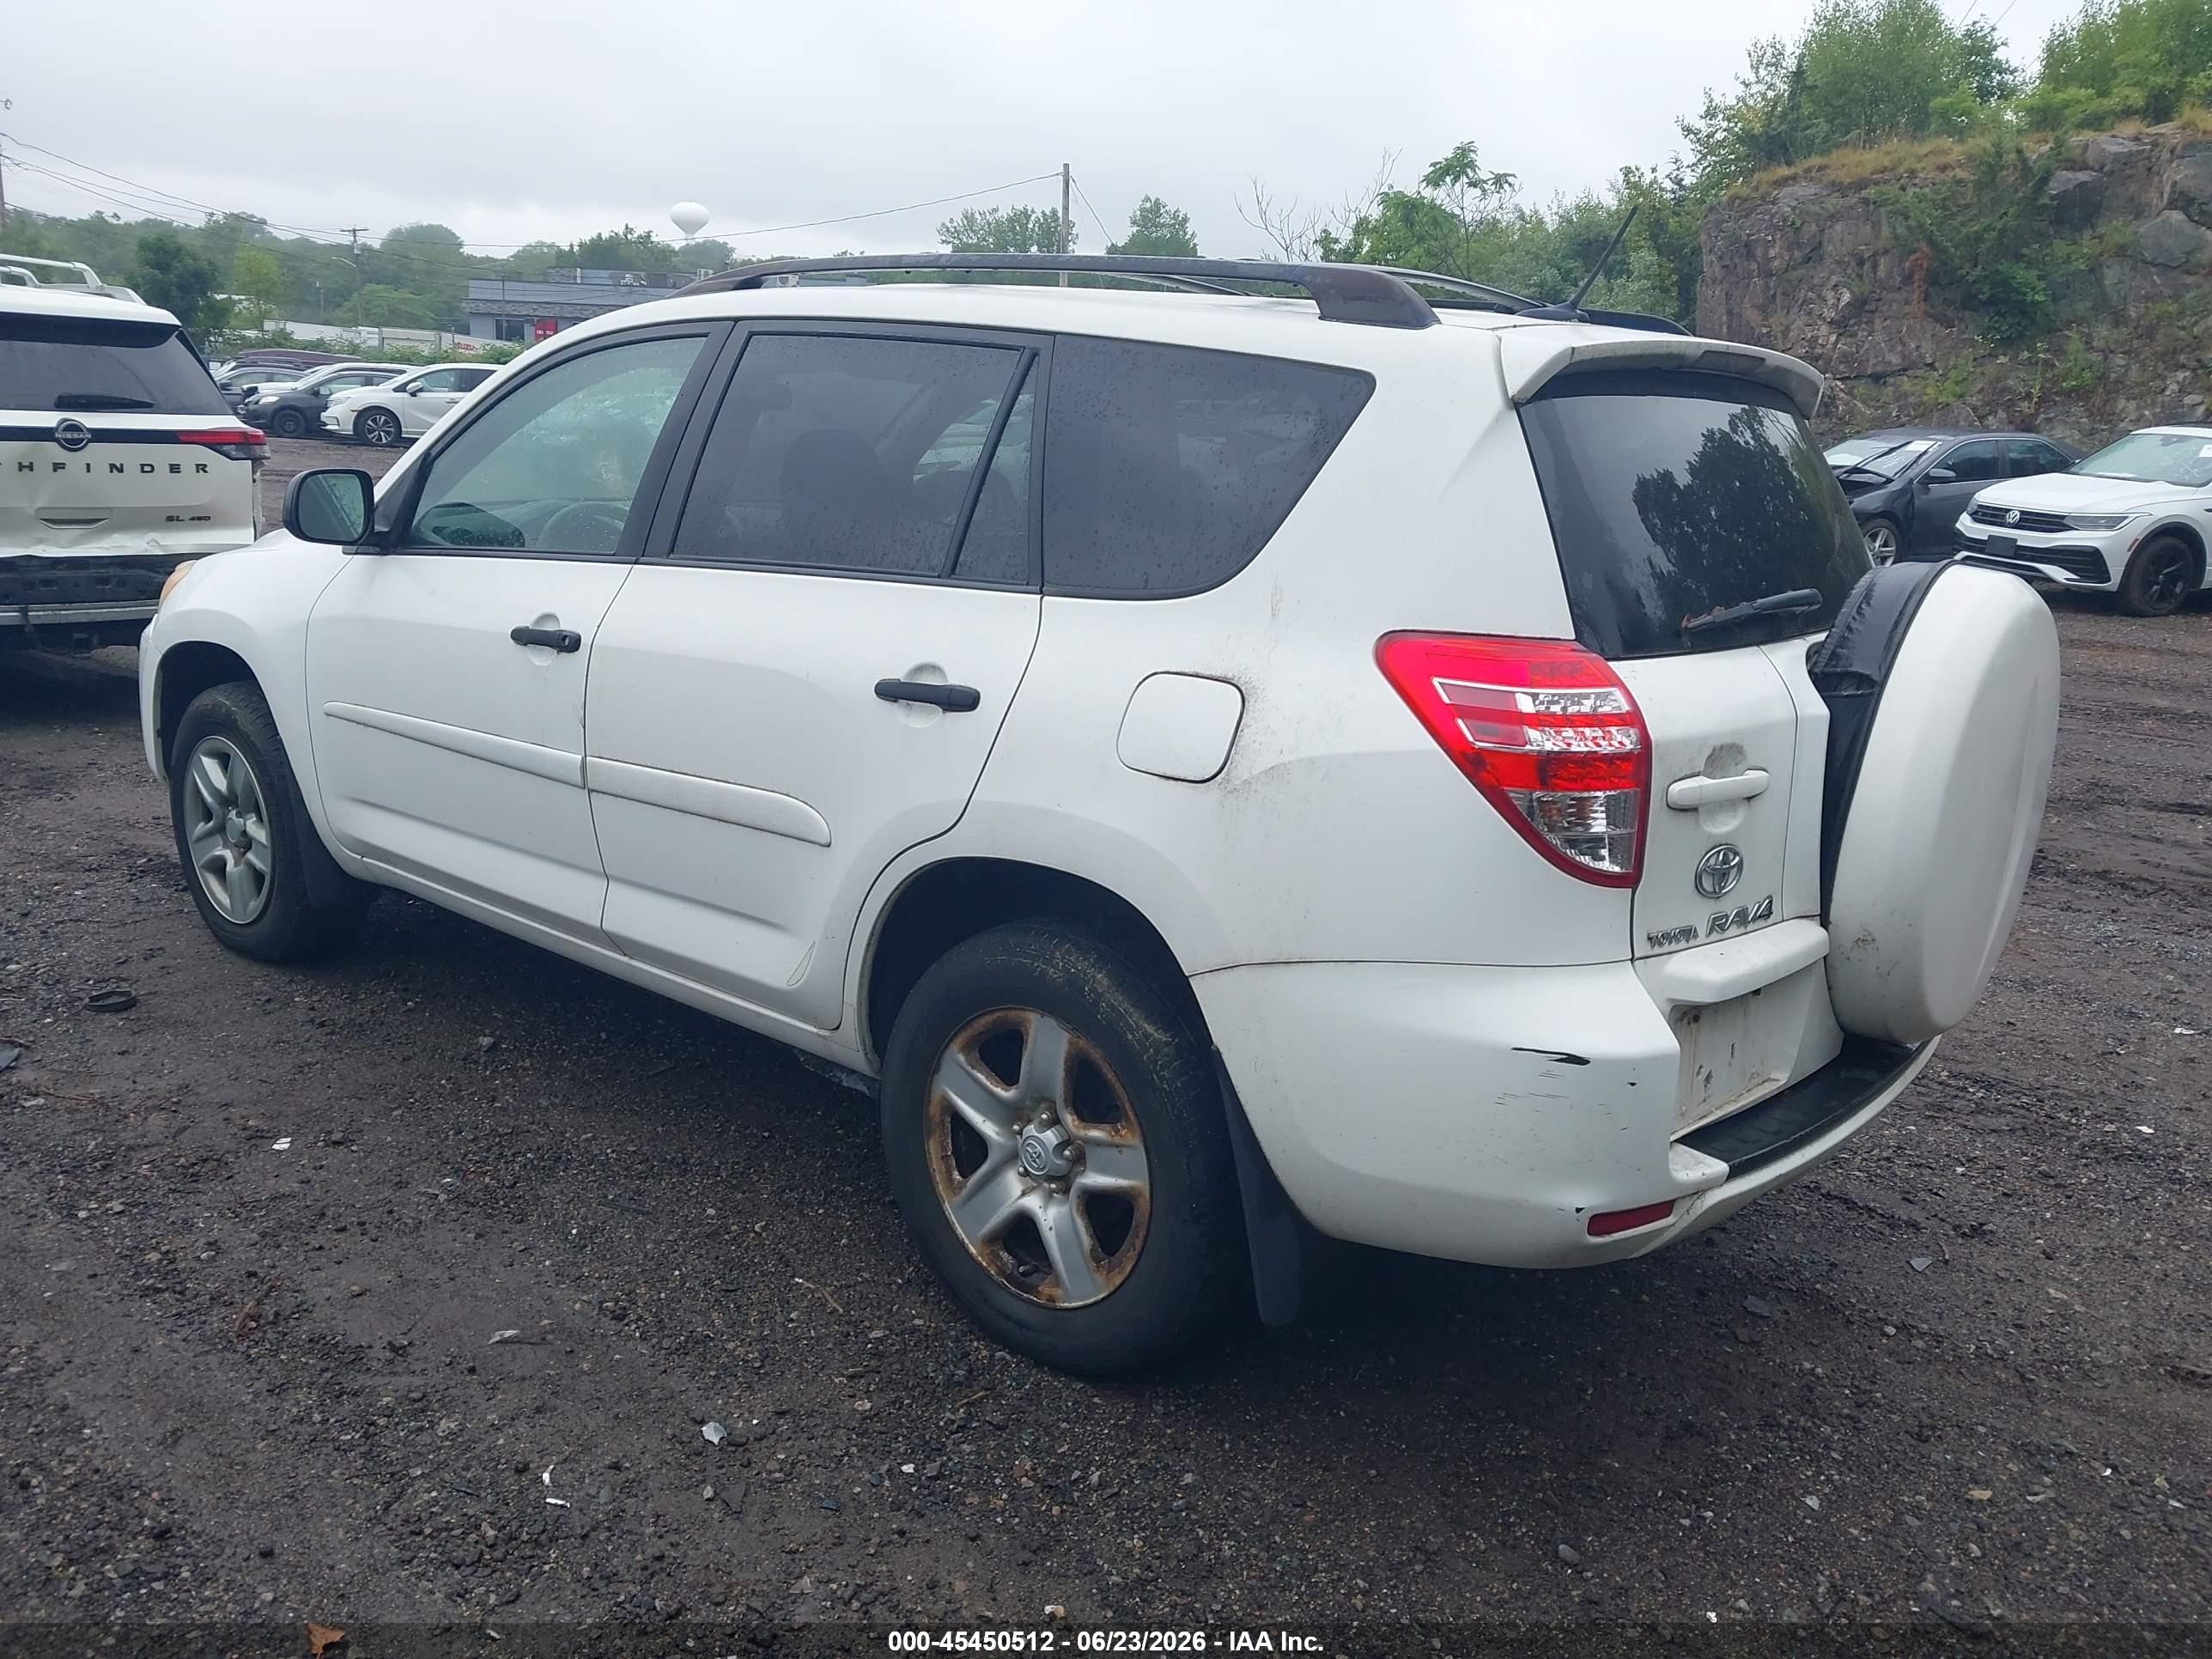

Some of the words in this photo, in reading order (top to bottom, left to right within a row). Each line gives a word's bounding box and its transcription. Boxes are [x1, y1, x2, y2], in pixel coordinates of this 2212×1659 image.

[0, 461, 209, 474] HFINDER
[1647, 925, 1699, 948] TOYOTA
[1705, 895, 1774, 939] RAV4
